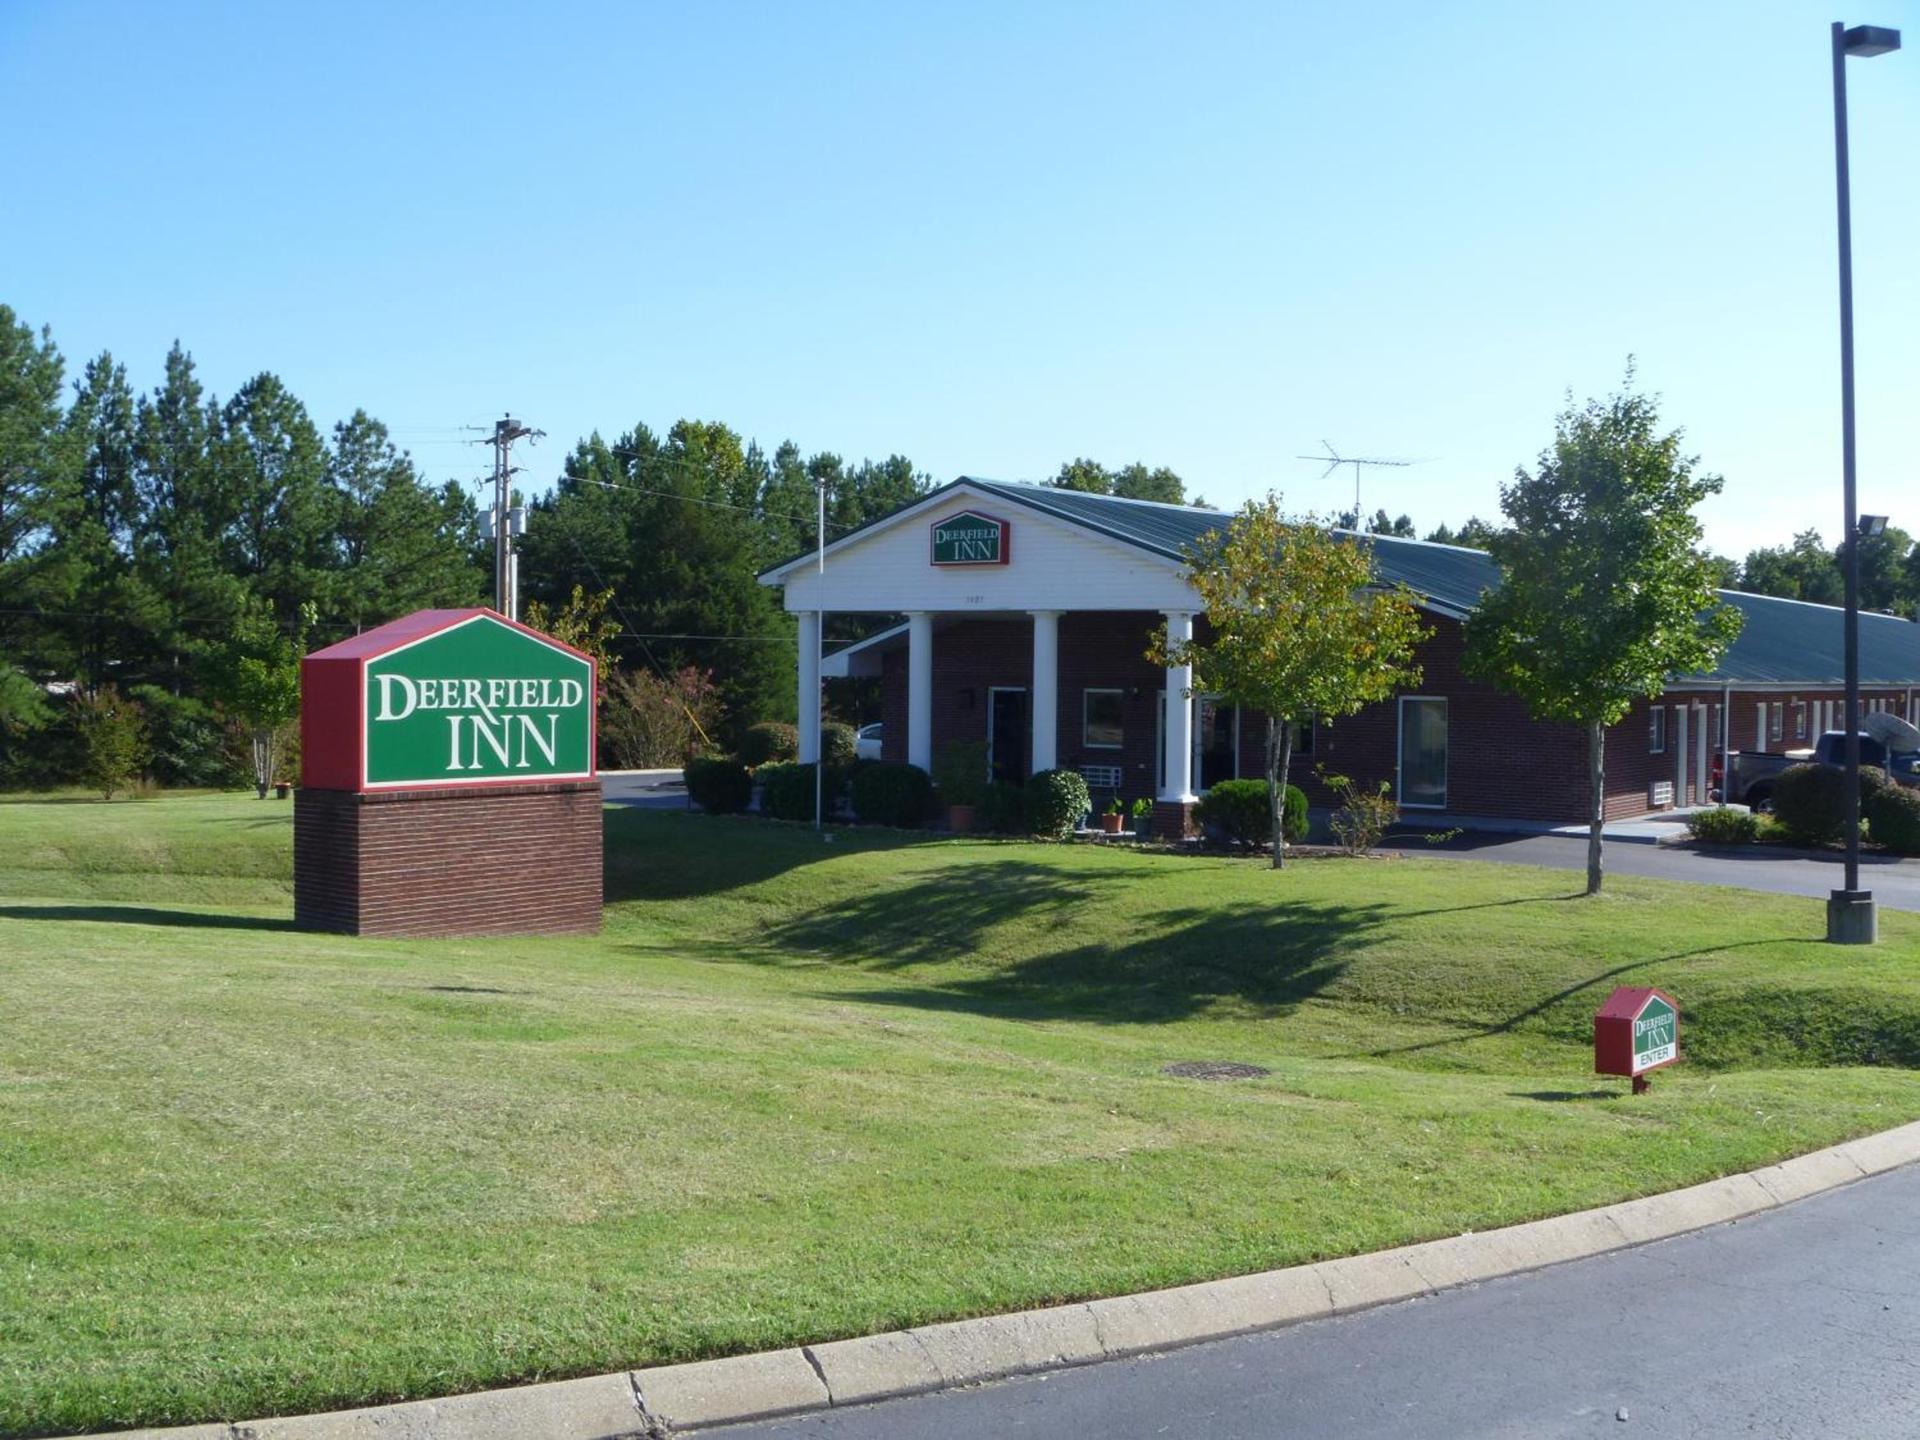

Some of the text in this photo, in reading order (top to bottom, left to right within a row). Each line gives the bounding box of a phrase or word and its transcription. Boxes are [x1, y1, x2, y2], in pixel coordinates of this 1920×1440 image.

[934, 528, 999, 544] DEERFIELD
[953, 541, 992, 560] INN
[374, 673, 584, 724] DEERFIELD
[445, 714, 561, 770] INN
[1635, 1012, 1674, 1038] DEERFIELD
[1647, 1026, 1670, 1050] INN
[1639, 1046, 1670, 1067] ENTER
